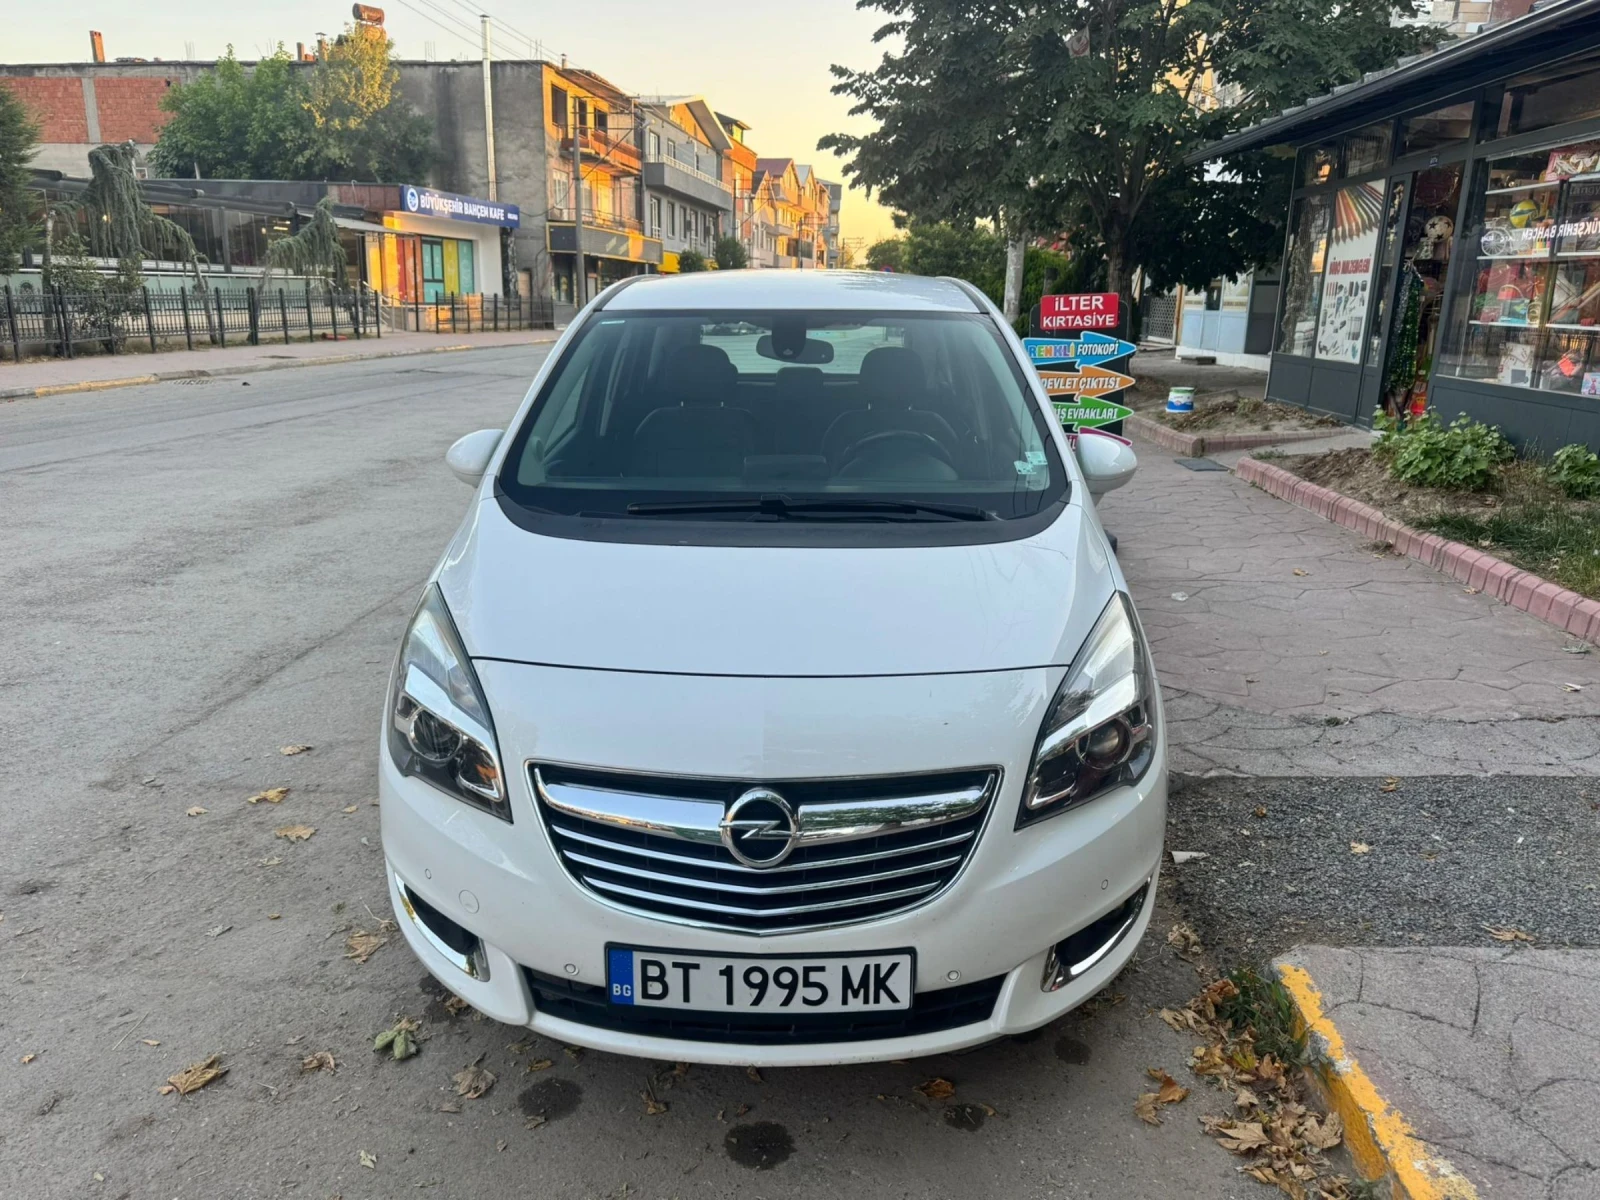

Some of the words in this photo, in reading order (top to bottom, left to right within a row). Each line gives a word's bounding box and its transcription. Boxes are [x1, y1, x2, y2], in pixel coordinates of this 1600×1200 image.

[420, 193, 463, 213] BÜYÜKŞEHİR
[489, 206, 505, 220] KAFE
[1055, 296, 1104, 311] İLTER
[1043, 312, 1115, 328] KIRTASİYE
[1028, 342, 1075, 358] RENKLİ
[1077, 341, 1119, 355] FOTOKOPİ
[1079, 377, 1121, 392] ÇIKTISI
[1067, 408, 1118, 420] EVRAKLARI
[612, 983, 632, 997] BG
[640, 959, 700, 1003] BT
[718, 964, 829, 1007] 1995
[841, 961, 901, 1006] MK
